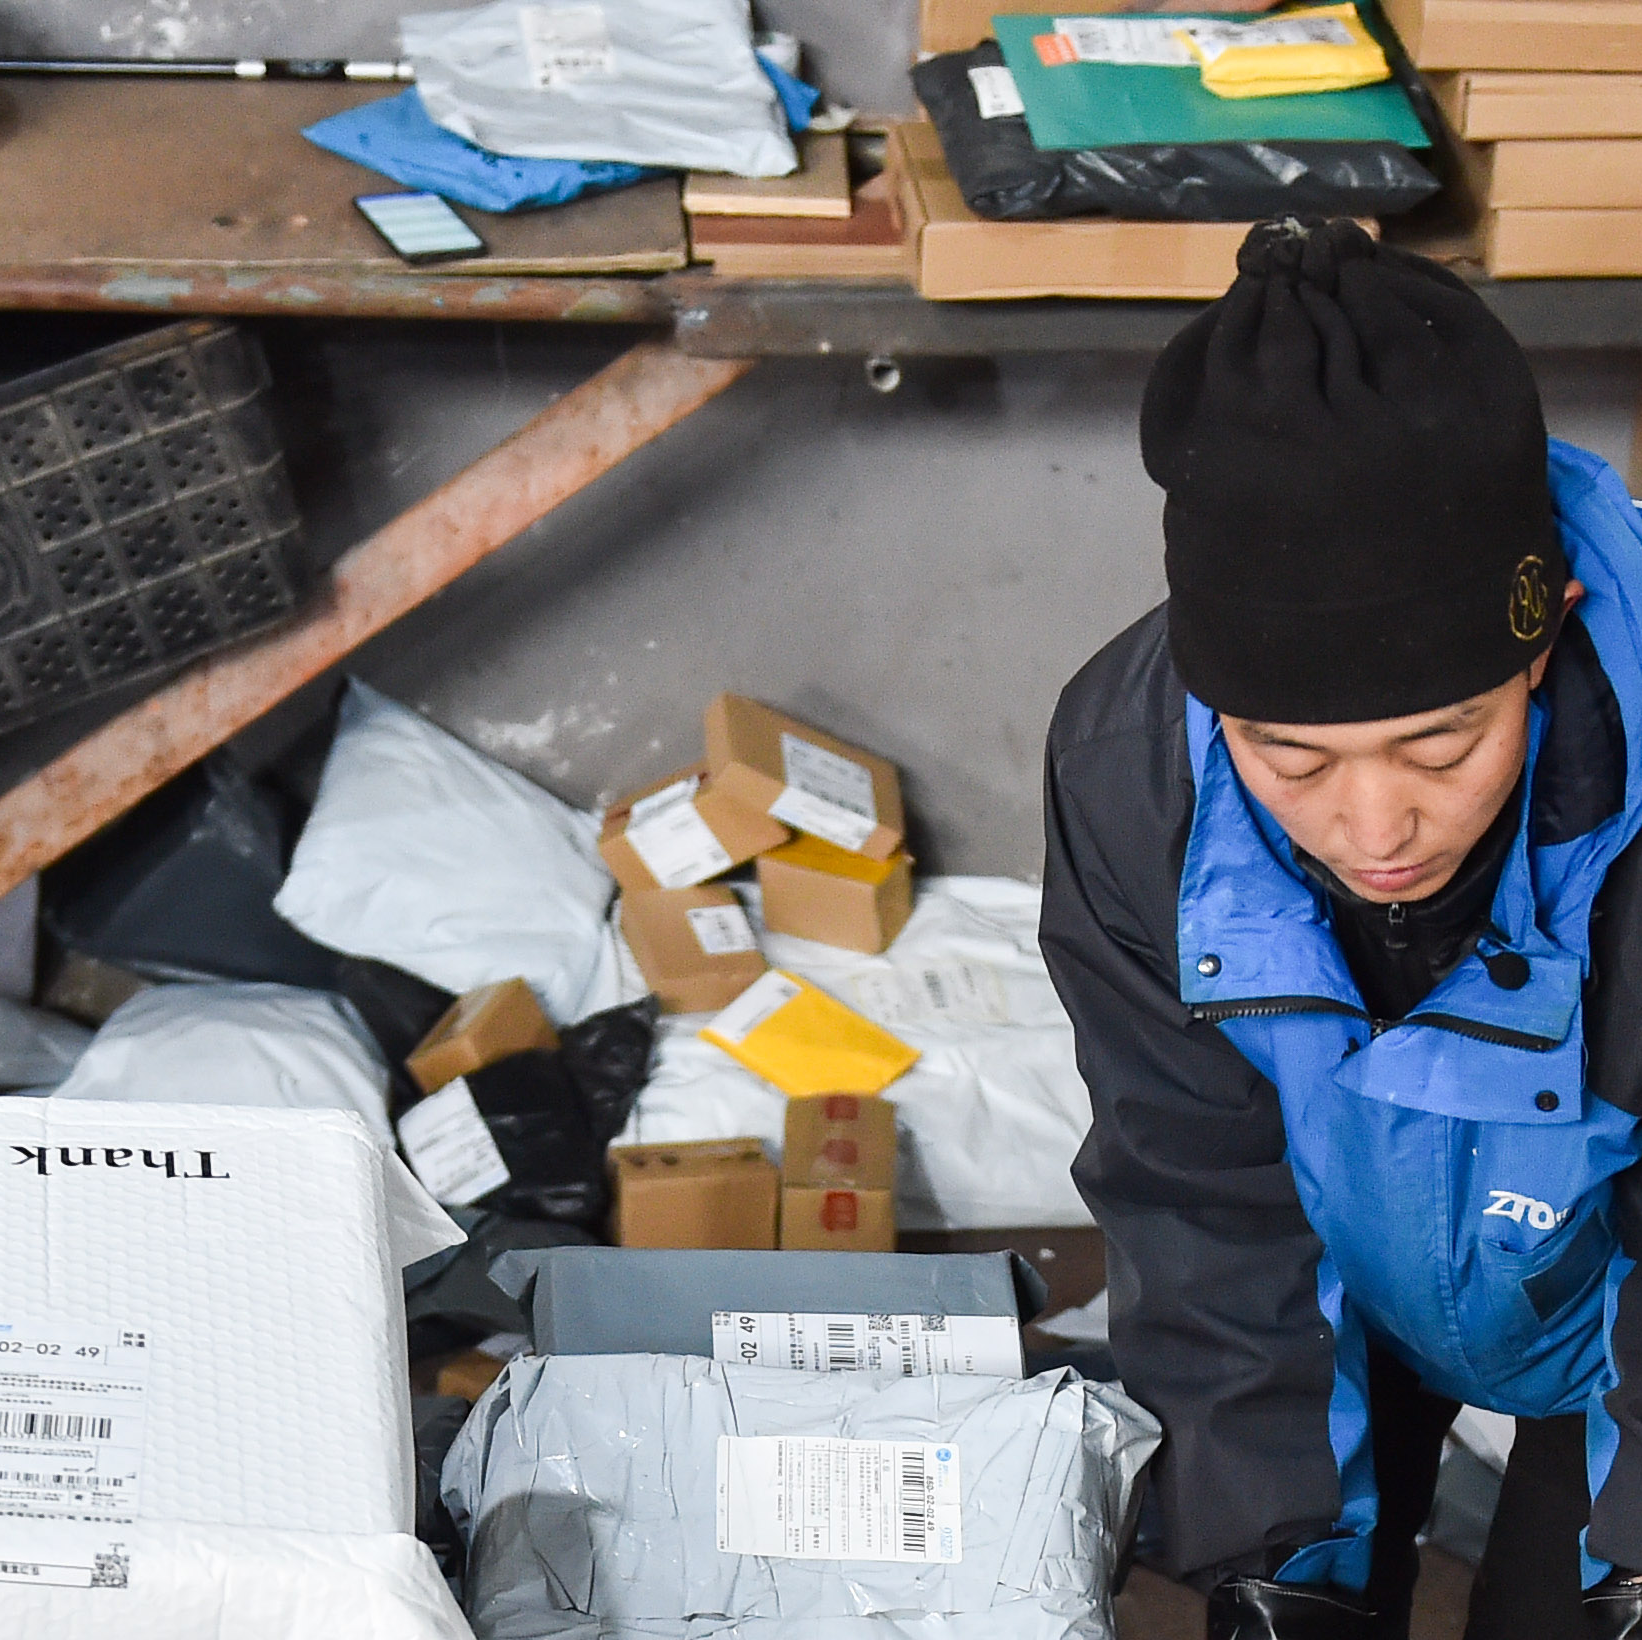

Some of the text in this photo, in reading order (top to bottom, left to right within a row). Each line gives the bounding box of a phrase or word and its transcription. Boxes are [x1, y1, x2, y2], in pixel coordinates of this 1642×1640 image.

[12, 1144, 230, 1179] Thank
[1483, 1190, 1555, 1230] ZTO
[739, 1316, 755, 1333] 49
[75, 1346, 100, 1357] 49
